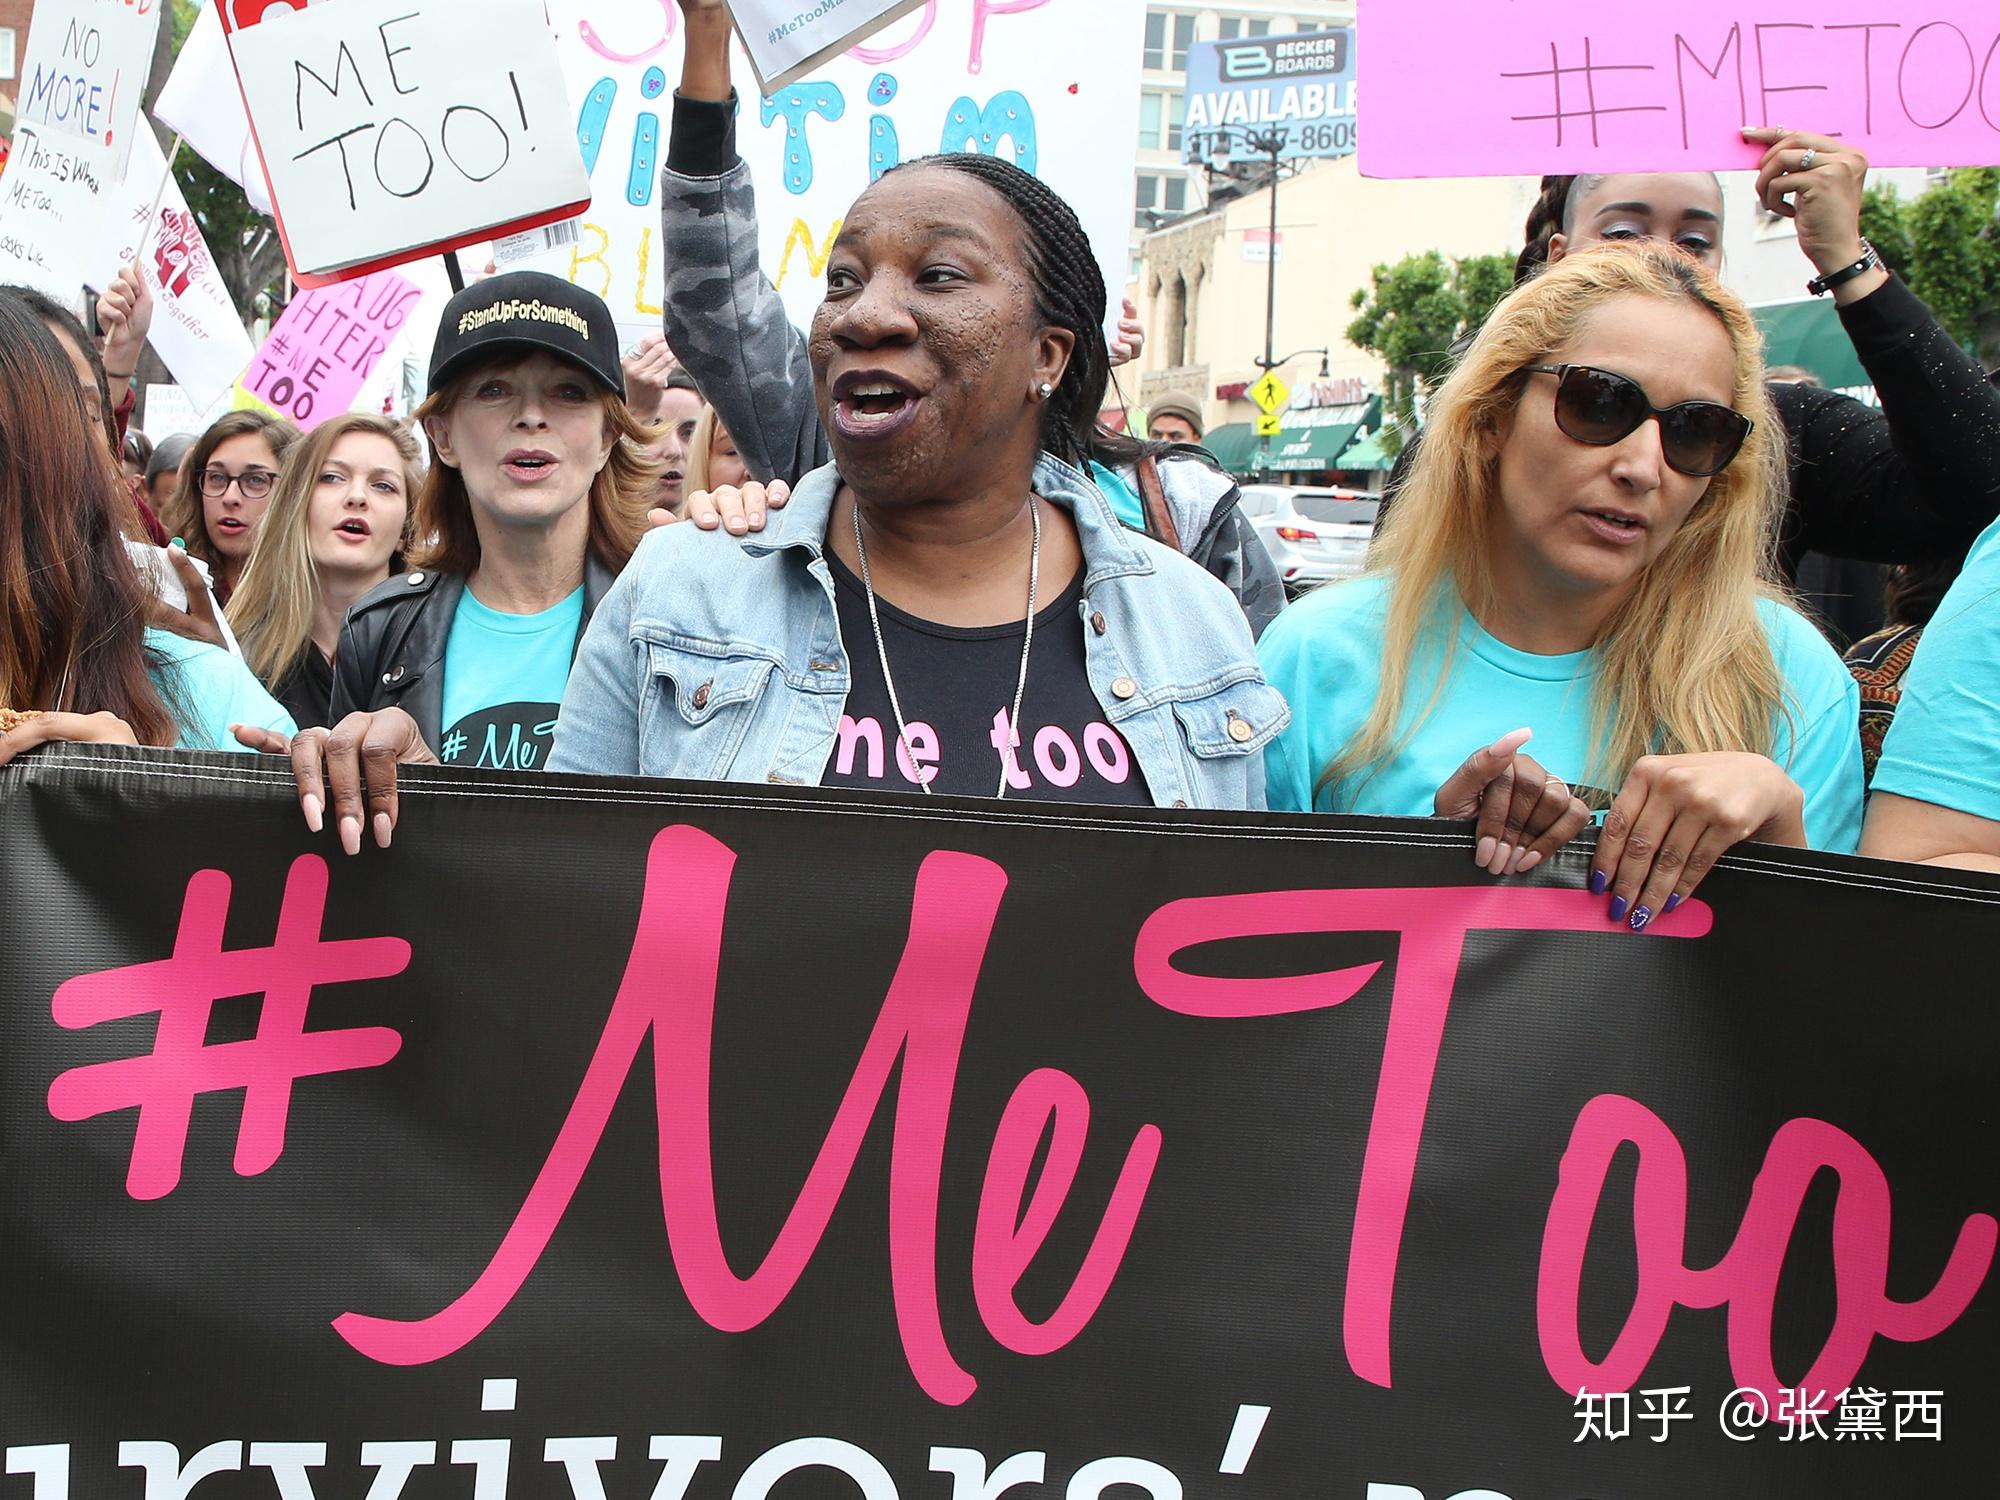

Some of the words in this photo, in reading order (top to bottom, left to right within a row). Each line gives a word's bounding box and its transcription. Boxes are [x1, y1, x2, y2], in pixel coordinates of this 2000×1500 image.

[62, 16, 101, 69] NO
[294, 11, 421, 132] ME
[1274, 54, 1336, 74] BOARDS
[1275, 38, 1337, 58] BECKER
[26, 62, 120, 147] MORE!
[1500, 21, 2000, 151] #METO
[20, 127, 52, 170] This
[292, 70, 537, 211] TOO!
[292, 290, 387, 381] HTER
[457, 298, 590, 342] #StandUpForSomething
[253, 359, 315, 421] TOO
[835, 713, 941, 785] me
[989, 705, 1130, 790] too
[1133, 885, 1999, 1426] Too
